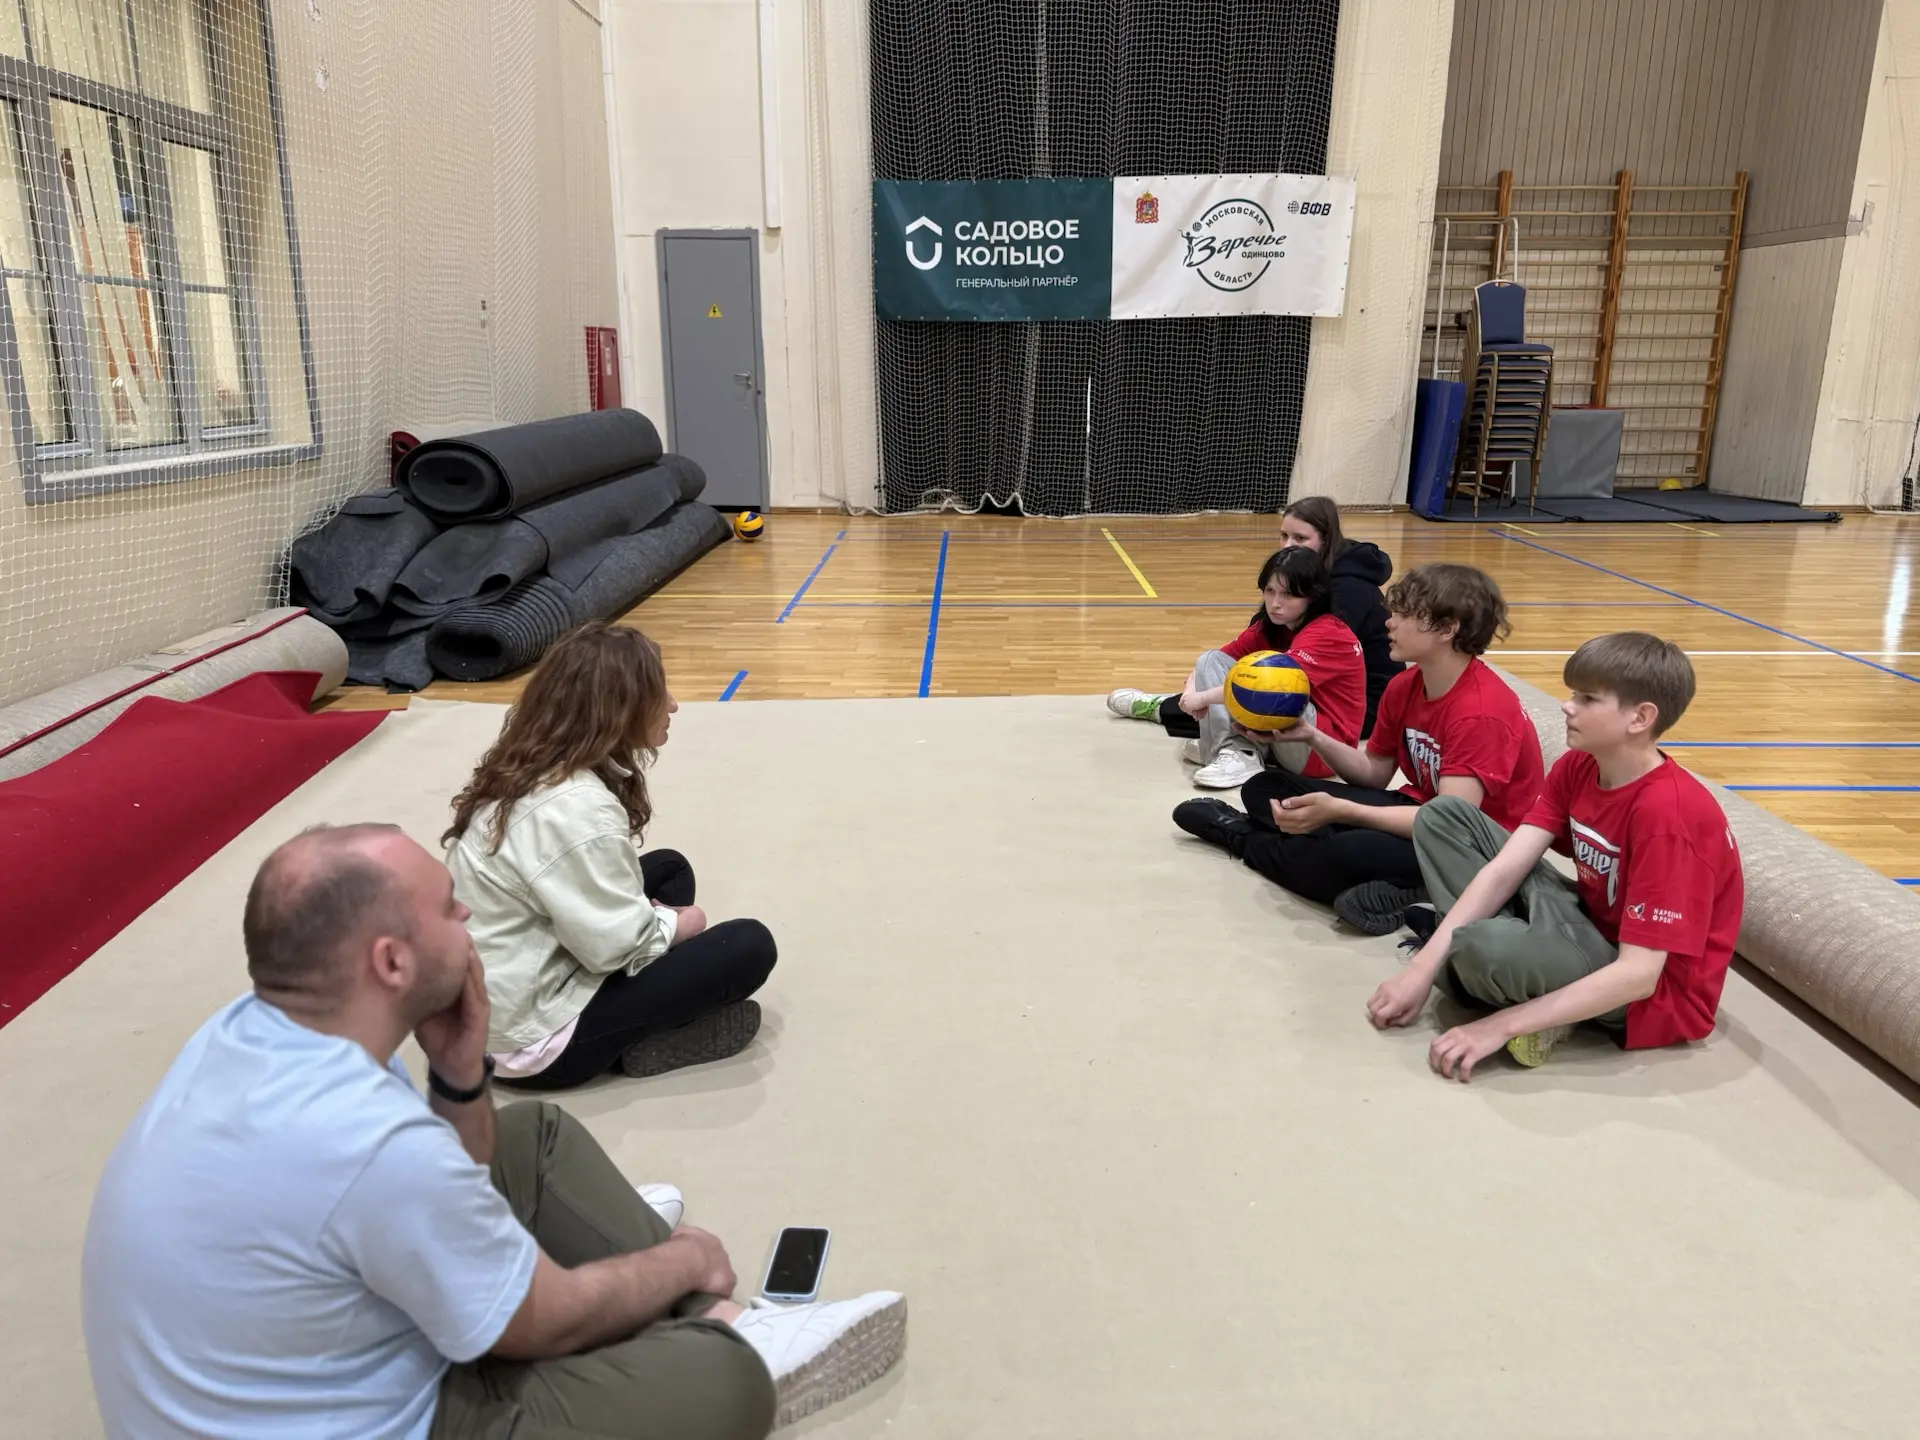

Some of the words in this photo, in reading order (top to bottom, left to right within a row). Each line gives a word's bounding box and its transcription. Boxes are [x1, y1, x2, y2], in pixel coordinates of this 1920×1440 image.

[1205, 206, 1264, 228] МОСКОВСКАЯ
[1299, 201, 1332, 216] ВФВ
[954, 218, 1080, 244] САДОВОЕ
[956, 245, 1064, 268] КОЛЬЦО
[1186, 234, 1288, 267] Заречье
[1241, 250, 1286, 260] ОДИНЦОВО
[956, 275, 1030, 288] ГЕНЕРАЛЬНЫЙ
[1031, 274, 1079, 287] ПАРТНЁР
[1212, 270, 1254, 285] ОБЛАСТЬ
